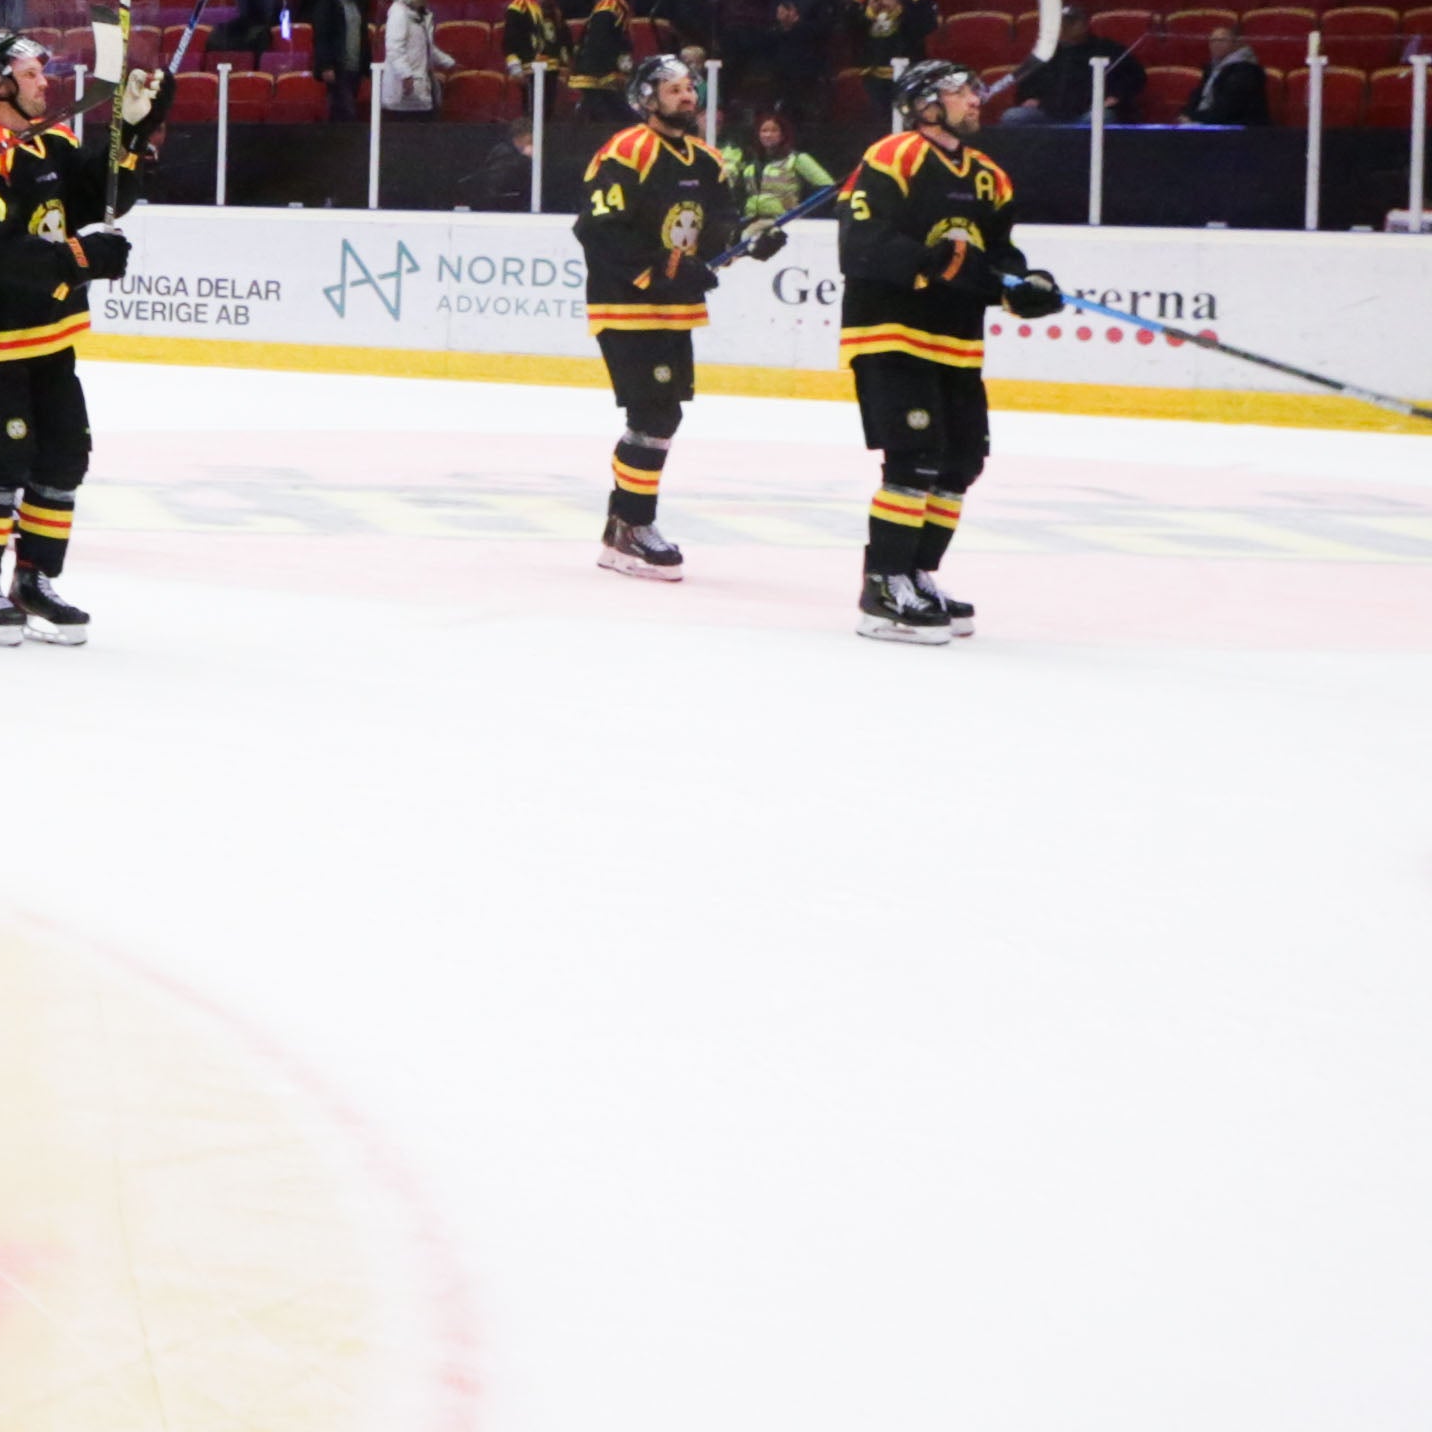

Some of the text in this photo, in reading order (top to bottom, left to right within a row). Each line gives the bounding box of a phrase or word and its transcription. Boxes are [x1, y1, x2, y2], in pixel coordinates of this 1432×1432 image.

[590, 183, 626, 216] 14
[975, 170, 995, 201] A
[105, 273, 281, 302] TUNGA DELAR
[104, 299, 250, 326] SVERIGE AB
[437, 294, 586, 320] ADVOKATE
